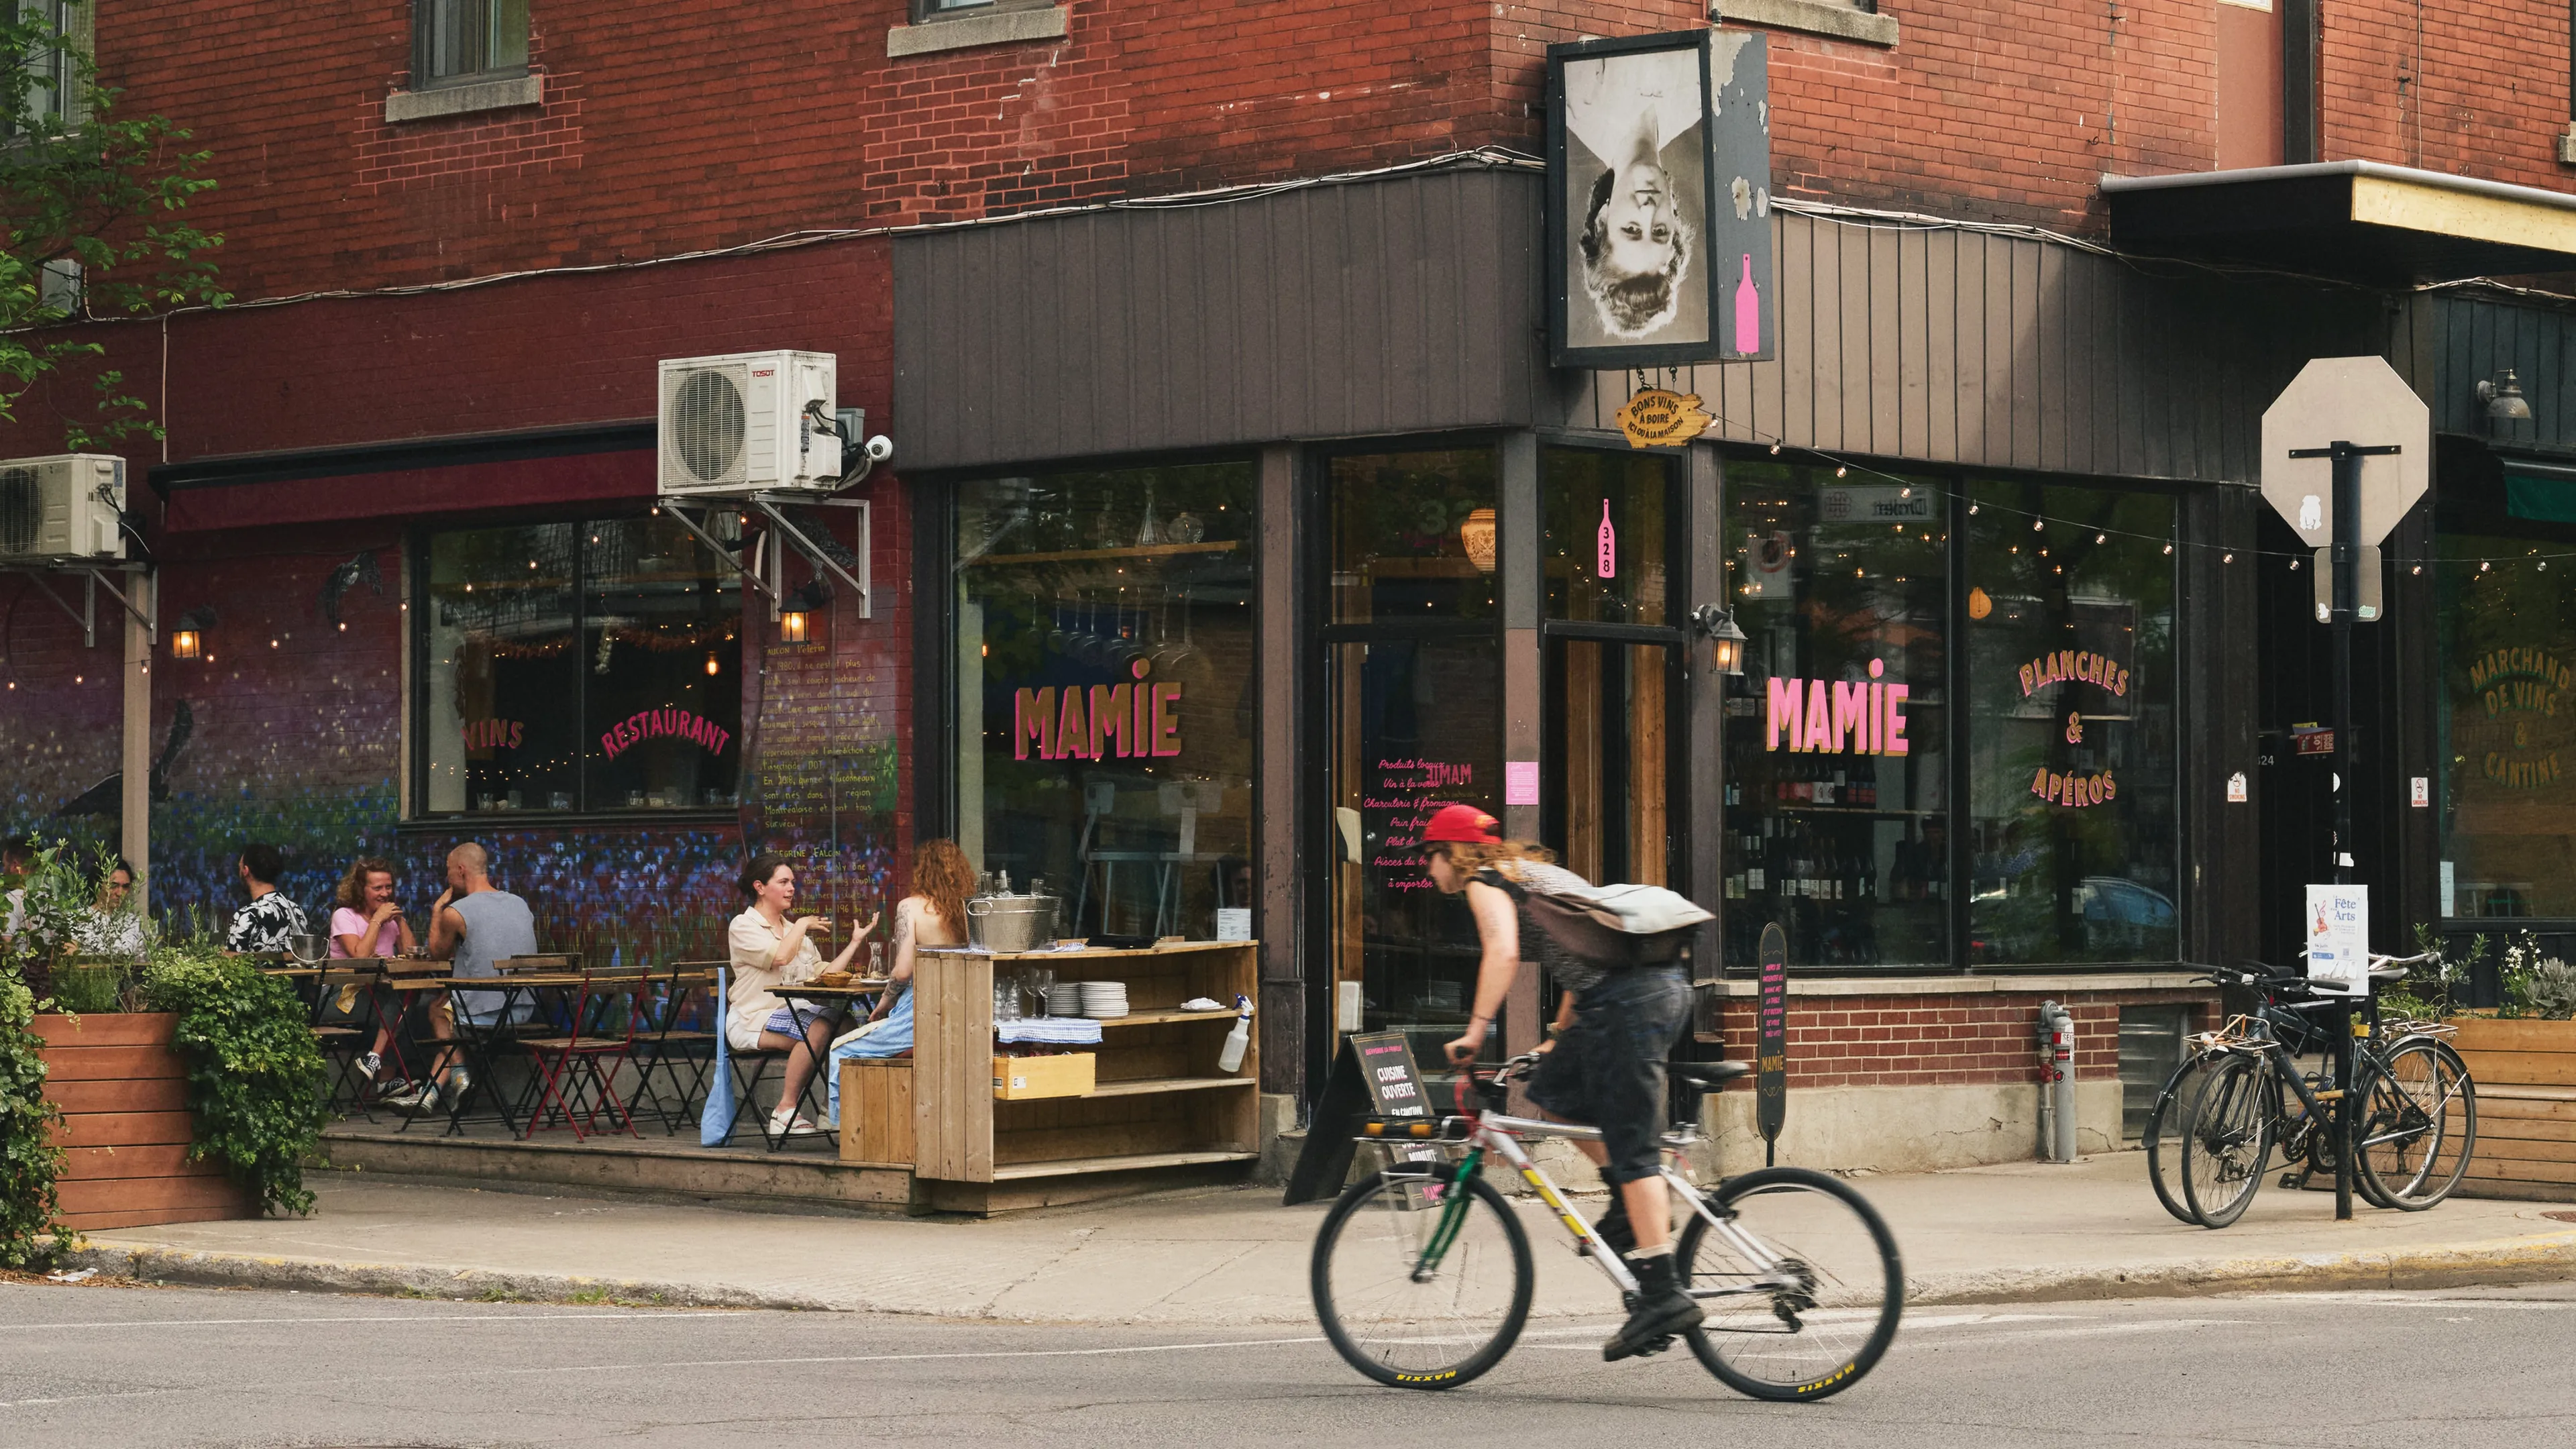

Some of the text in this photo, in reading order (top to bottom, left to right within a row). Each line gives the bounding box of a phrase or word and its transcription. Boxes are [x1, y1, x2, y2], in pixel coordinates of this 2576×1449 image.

[751, 370, 775, 378] TOSOT
[1631, 396, 1679, 419] BONS VINS
[1640, 412, 1670, 424] À BOIRE
[1627, 421, 1637, 434] ICI
[1650, 431, 1656, 439] LA
[1658, 416, 1684, 438] MAISON
[765, 645, 790, 655] AUCON
[845, 660, 861, 669] plus
[2019, 650, 2131, 697] PLANCHES
[2469, 647, 2570, 695] MARCHAND
[866, 673, 876, 682] de
[2485, 681, 2557, 718] DE VINS
[2065, 710, 2084, 744] &
[461, 718, 525, 751] VINS
[600, 708, 730, 761] RESTAURANT
[2514, 721, 2527, 749] &
[869, 745, 877, 753] de
[1378, 758, 1445, 770] Produits locaux
[2485, 749, 2561, 790] CANTINE
[763, 776, 773, 785] En
[1383, 777, 1397, 789] Vin
[1399, 779, 1405, 788] à
[1407, 777, 1416, 788] la
[2031, 766, 2116, 807] APÉROS
[764, 788, 871, 800] sont nés dans région
[820, 803, 828, 812] et
[835, 803, 848, 812] ont
[855, 802, 872, 811] tous
[1363, 797, 1411, 808] Charcuterie
[765, 819, 796, 828] survécu
[1390, 816, 1409, 827] Pain
[1385, 836, 1405, 847] Plat
[1374, 855, 1403, 866] Pièces
[1404, 855, 1417, 865] du
[852, 875, 876, 885] couple
[1388, 878, 1434, 894] à emporter
[2334, 898, 2357, 909] Fête
[837, 904, 849, 913] 196
[853, 904, 863, 916] by
[2334, 910, 2356, 922] Arts
[1377, 1065, 1407, 1083] CUISINE
[1381, 1082, 1416, 1101] OUVERTE
[1400, 1106, 1423, 1116] CONTINU
[1396, 1370, 1457, 1382] MAXXIS
[1798, 1362, 1855, 1393] MAXXIS
